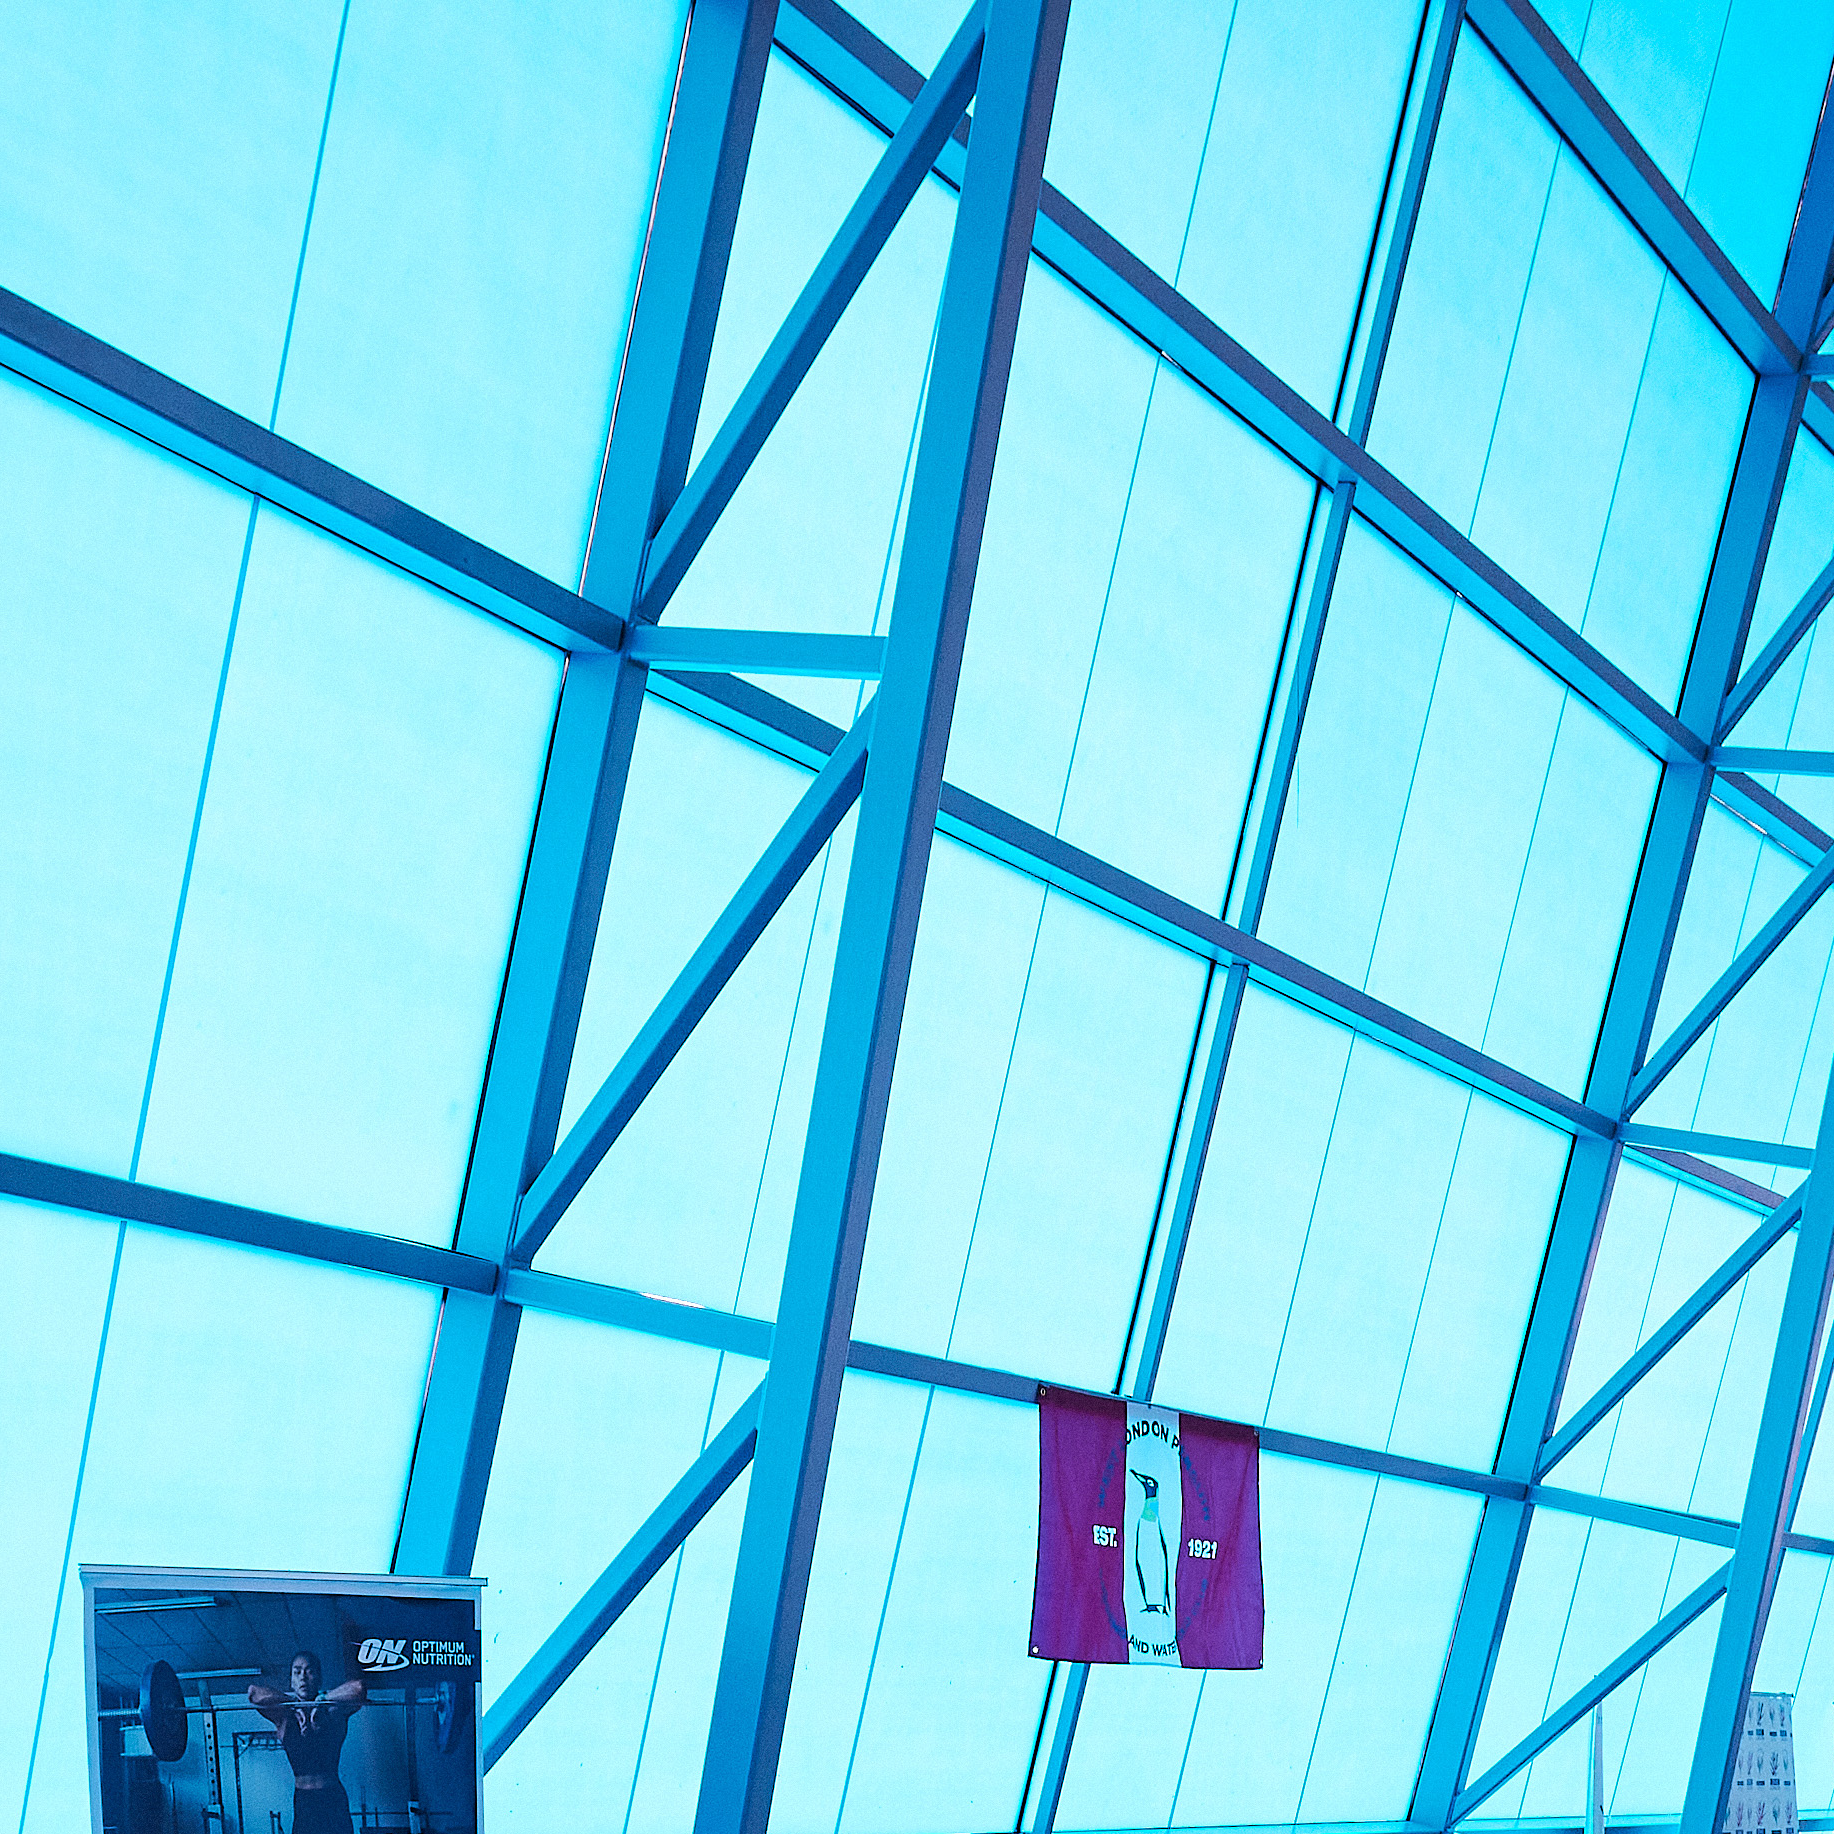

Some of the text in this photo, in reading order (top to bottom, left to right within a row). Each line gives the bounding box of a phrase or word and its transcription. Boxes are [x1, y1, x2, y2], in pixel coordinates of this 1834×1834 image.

[1092, 1524, 1118, 1548] EST.
[1187, 1538, 1218, 1560] 1921
[357, 1638, 410, 1670] ON
[412, 1640, 465, 1654] OPTIMUM
[1128, 1633, 1149, 1655] AND
[412, 1652, 472, 1667] NUTRITION
